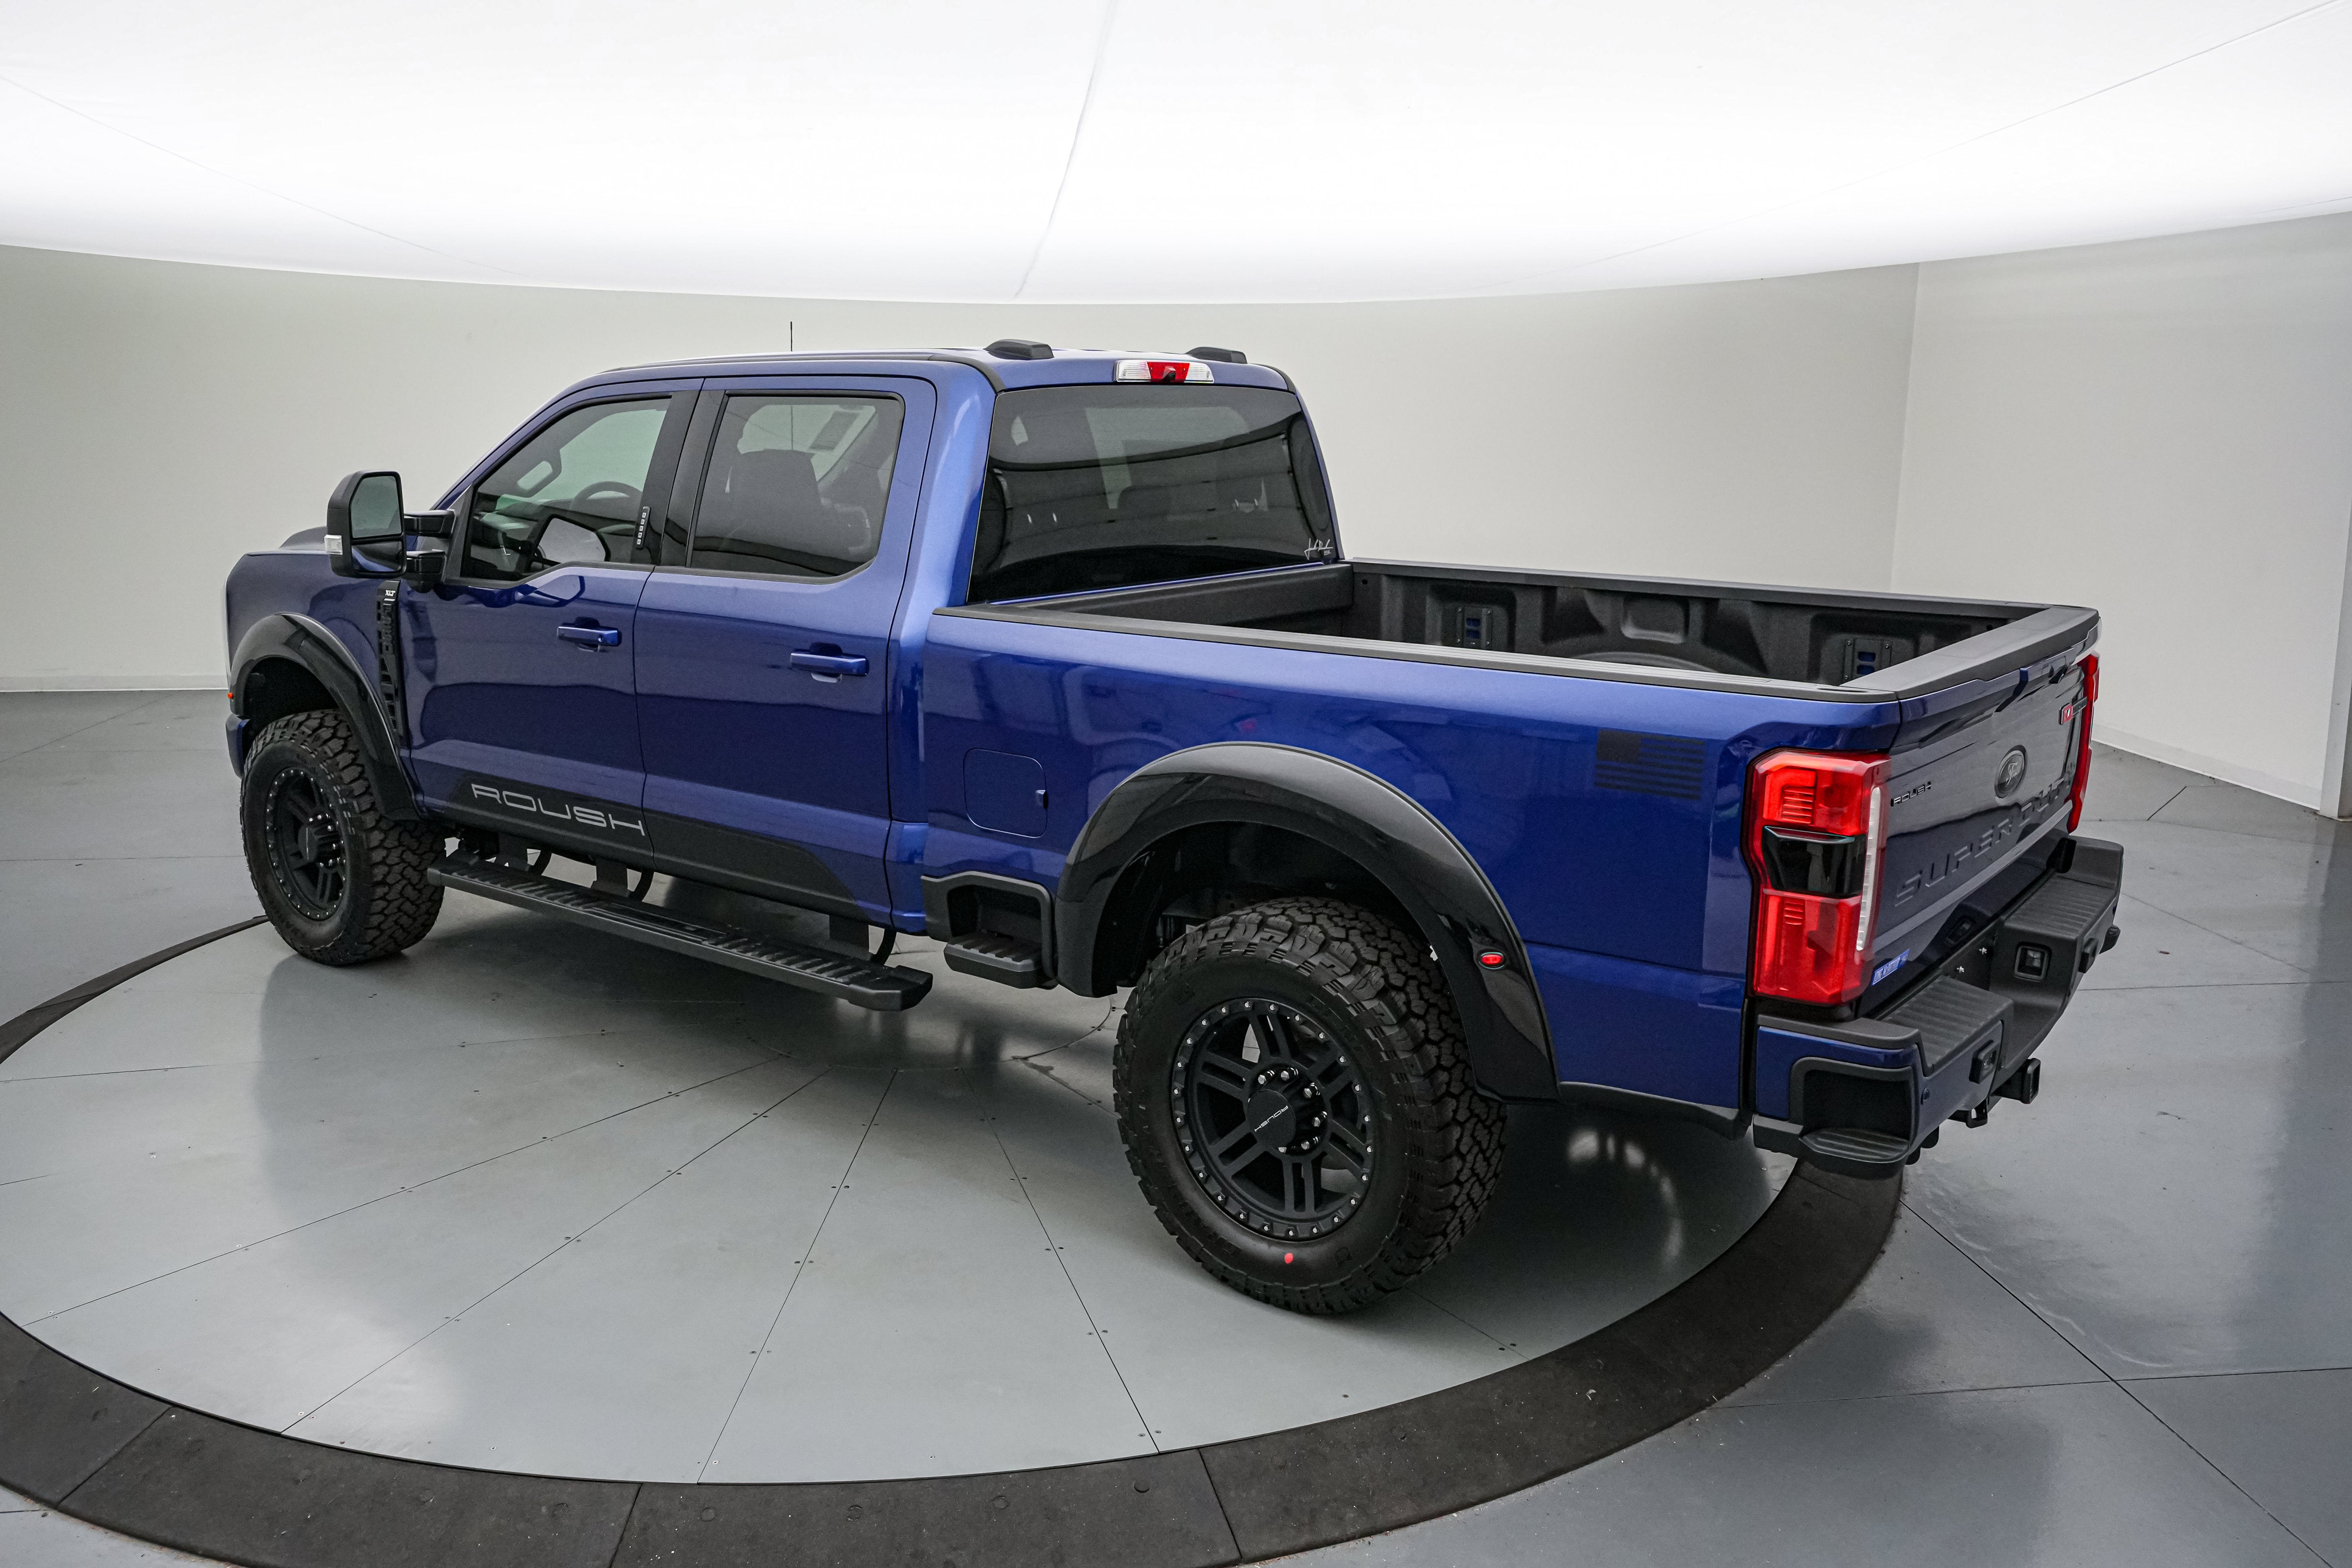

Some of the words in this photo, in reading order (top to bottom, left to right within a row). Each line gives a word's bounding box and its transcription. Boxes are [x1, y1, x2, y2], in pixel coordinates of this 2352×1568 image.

[471, 783, 645, 836] ROUSH
[1891, 781, 1932, 807] ROUSH
[1895, 816, 2013, 907] SUPER
[1254, 1105, 1289, 1132] ROUSH
